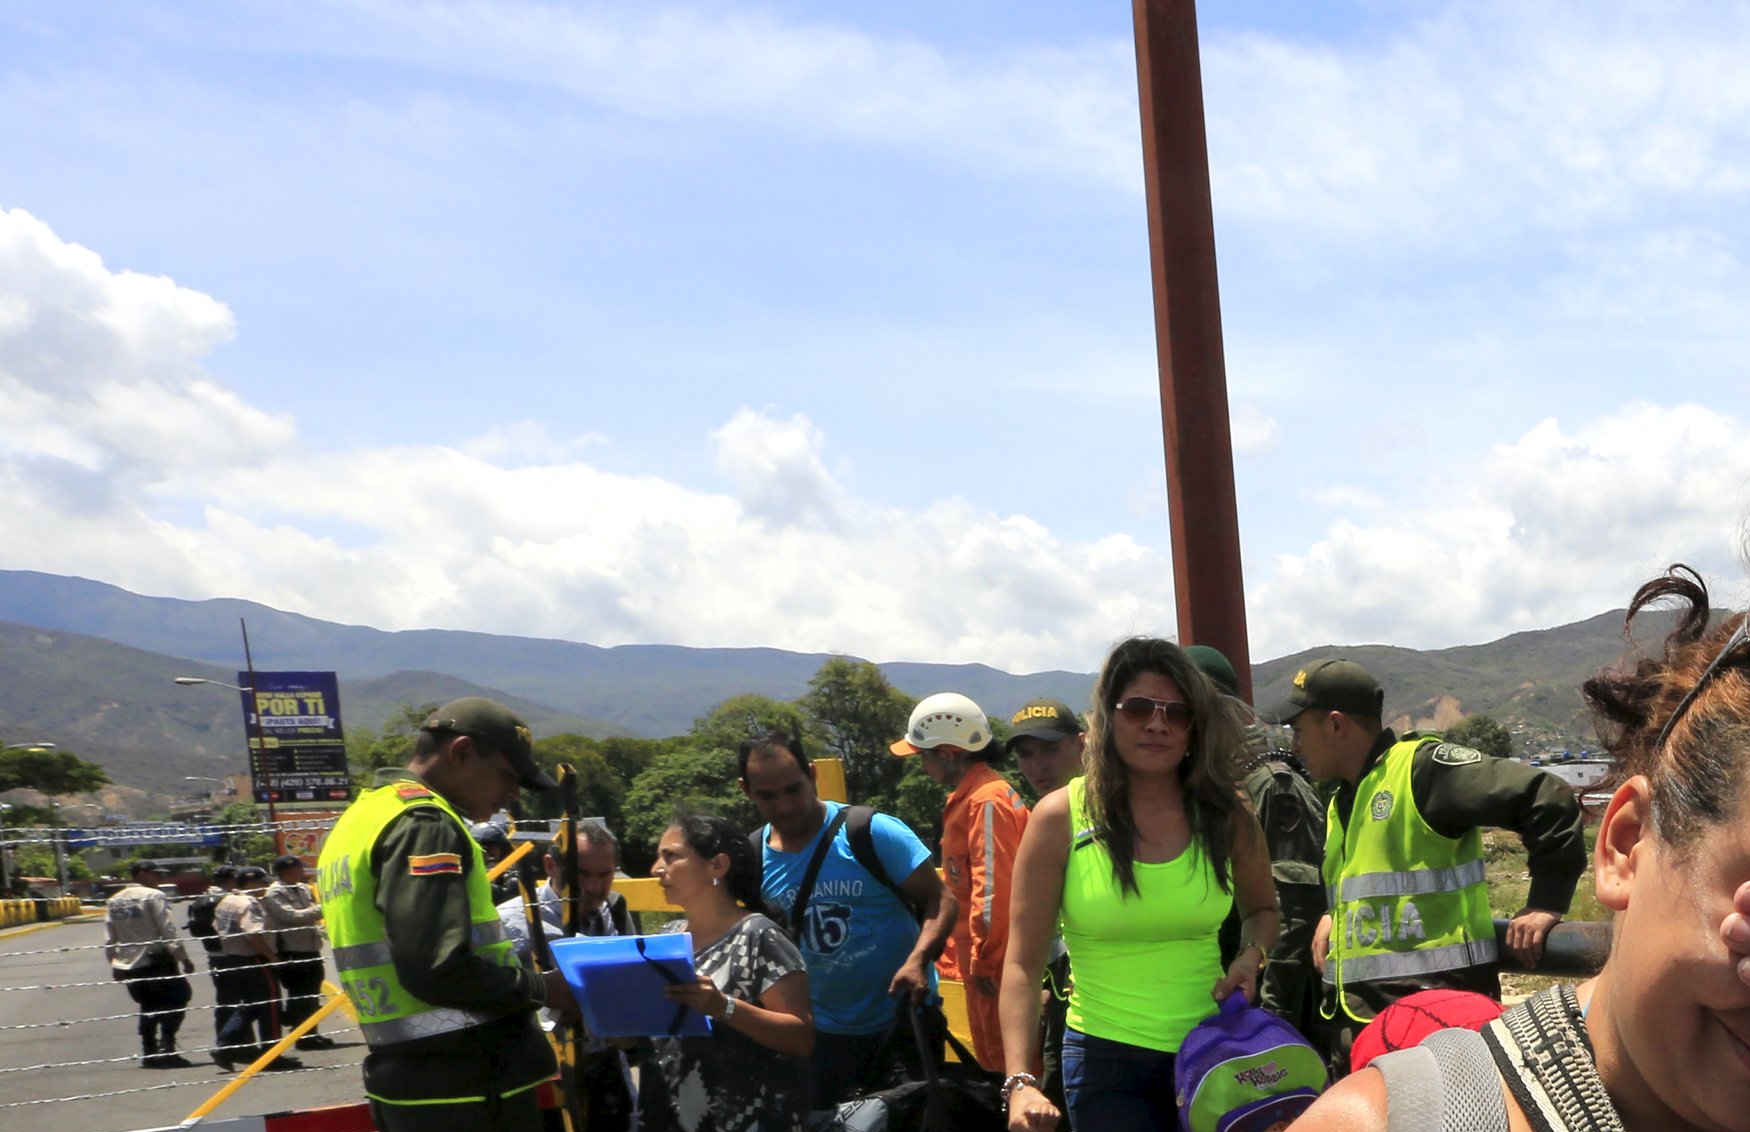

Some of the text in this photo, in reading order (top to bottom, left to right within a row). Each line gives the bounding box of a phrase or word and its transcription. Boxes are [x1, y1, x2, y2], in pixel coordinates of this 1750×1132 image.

[256, 699, 326, 716] POR TI
[1012, 706, 1058, 724] OLICIA
[1344, 902, 1426, 949] ICIA
